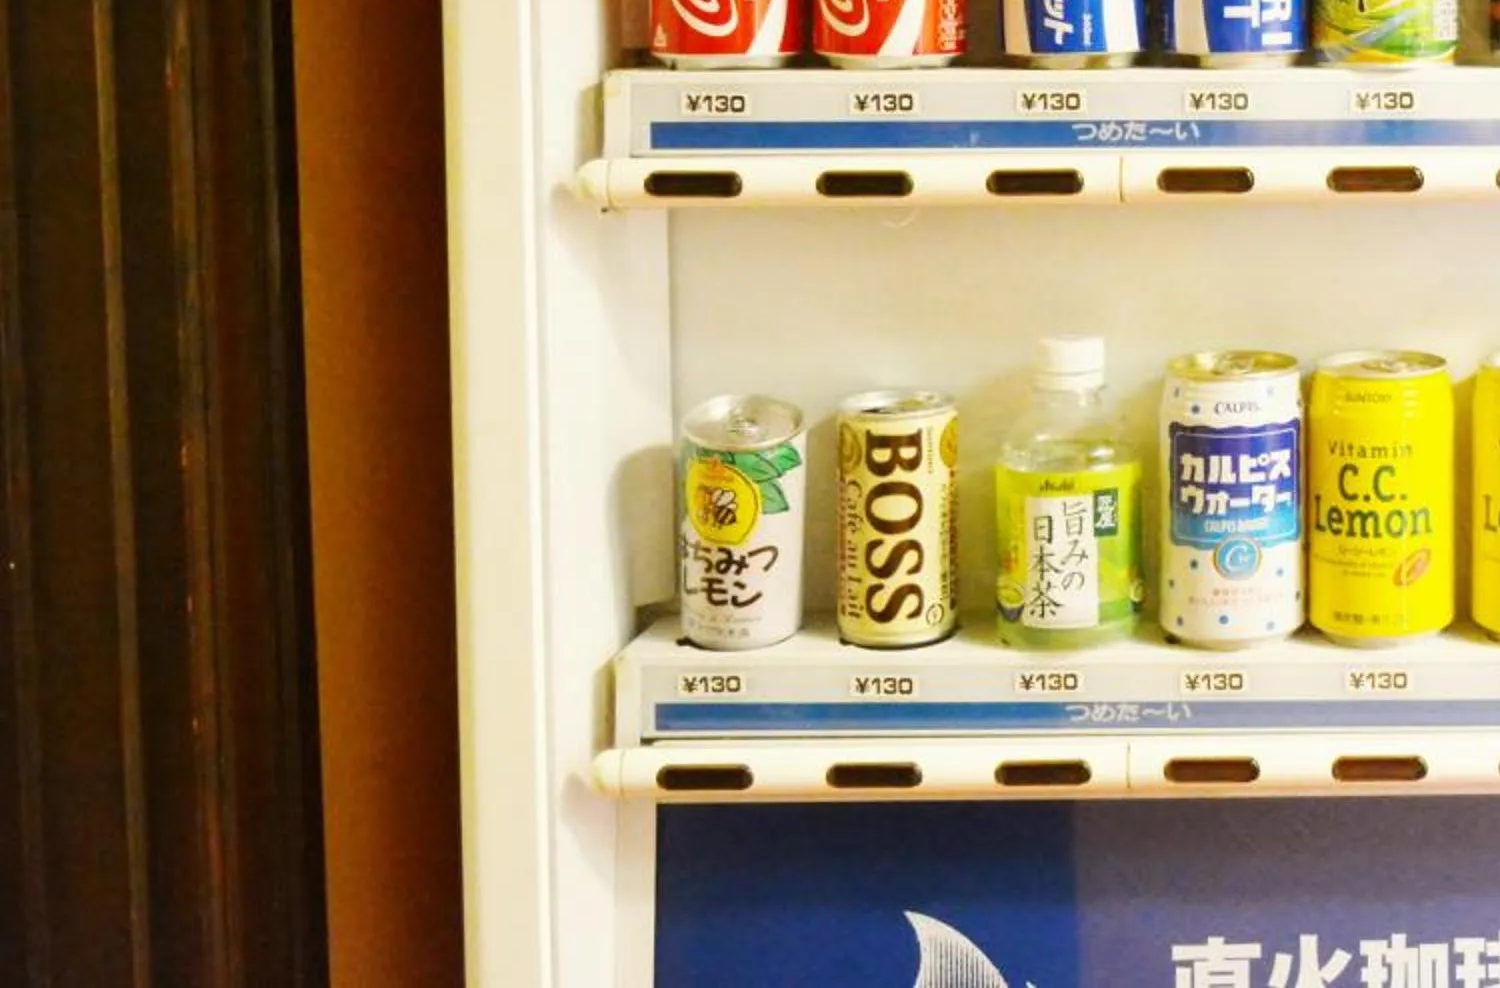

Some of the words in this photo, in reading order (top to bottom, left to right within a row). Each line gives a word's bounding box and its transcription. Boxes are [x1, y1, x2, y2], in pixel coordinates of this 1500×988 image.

[687, 92, 745, 113] ¥130
[853, 92, 913, 112] ¥130
[1022, 91, 1081, 111] ¥130
[1189, 91, 1249, 111] ¥130
[1355, 91, 1415, 110] ¥130
[1328, 439, 1413, 459] Vitamin
[1180, 448, 1292, 485] カルピス
[1338, 463, 1408, 503] C.C.
[864, 426, 925, 625] BOSS
[1314, 493, 1432, 538] Lemon
[1029, 514, 1064, 620] 日本茶
[682, 674, 742, 694] ¥130
[855, 676, 913, 696] ¥130
[1019, 672, 1078, 692] ¥130
[1184, 672, 1244, 692] ¥130
[1349, 671, 1408, 691] ¥130
